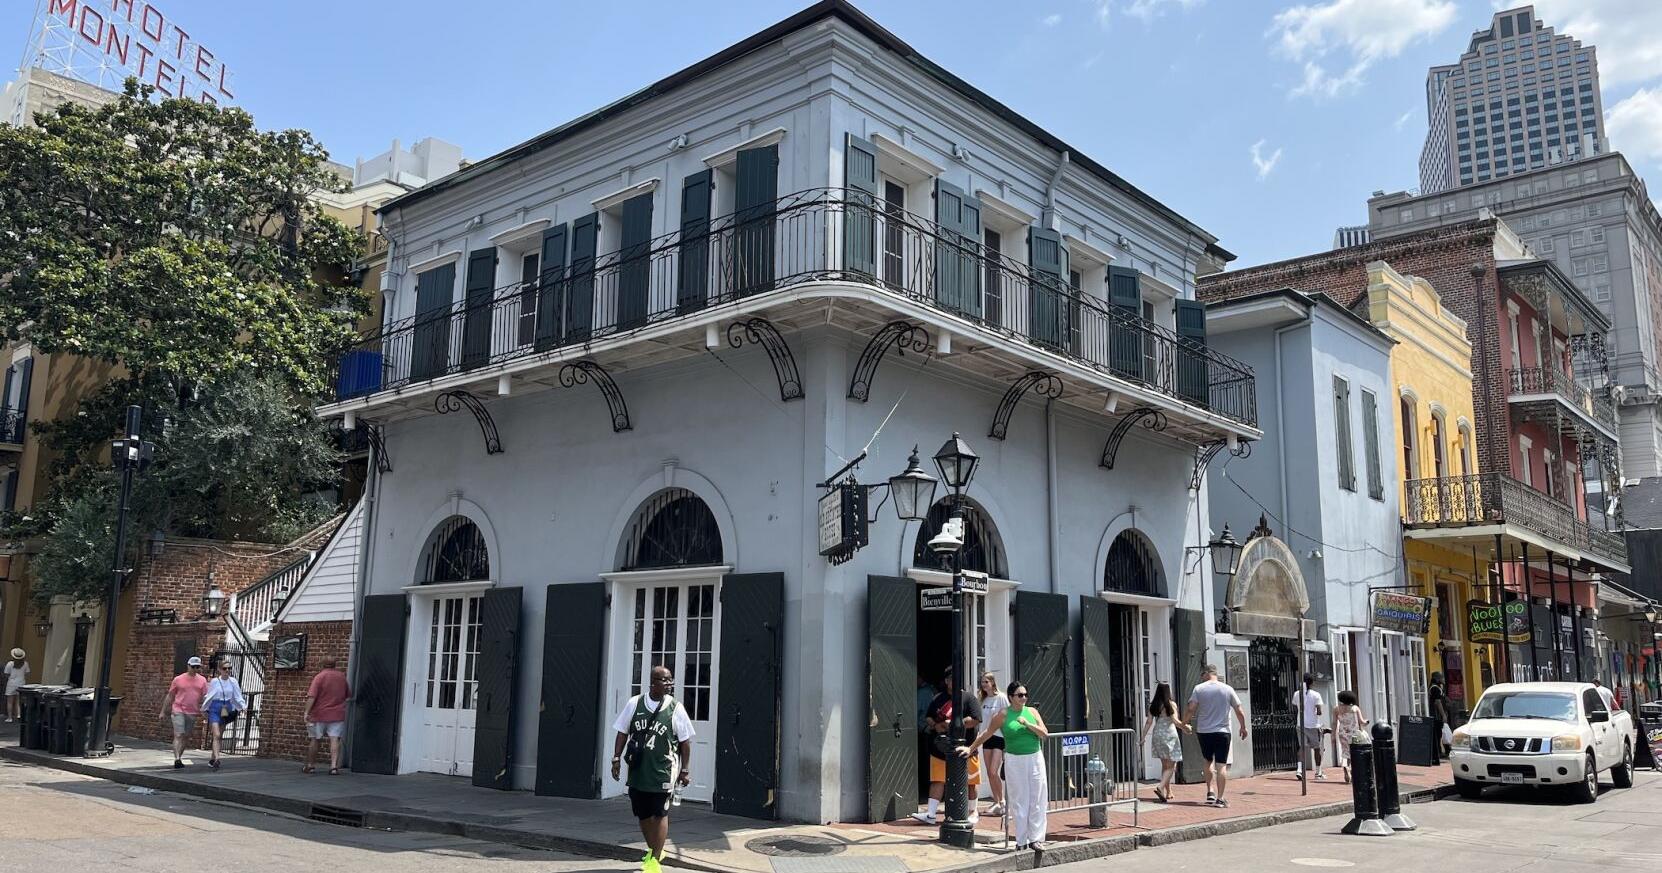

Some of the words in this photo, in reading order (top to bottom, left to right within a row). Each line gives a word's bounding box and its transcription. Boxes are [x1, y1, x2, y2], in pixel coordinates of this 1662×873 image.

[961, 576, 987, 590] Bourbon
[922, 594, 953, 607] Bienville
[1472, 617, 1504, 633] BLUES
[644, 733, 656, 750] 4
